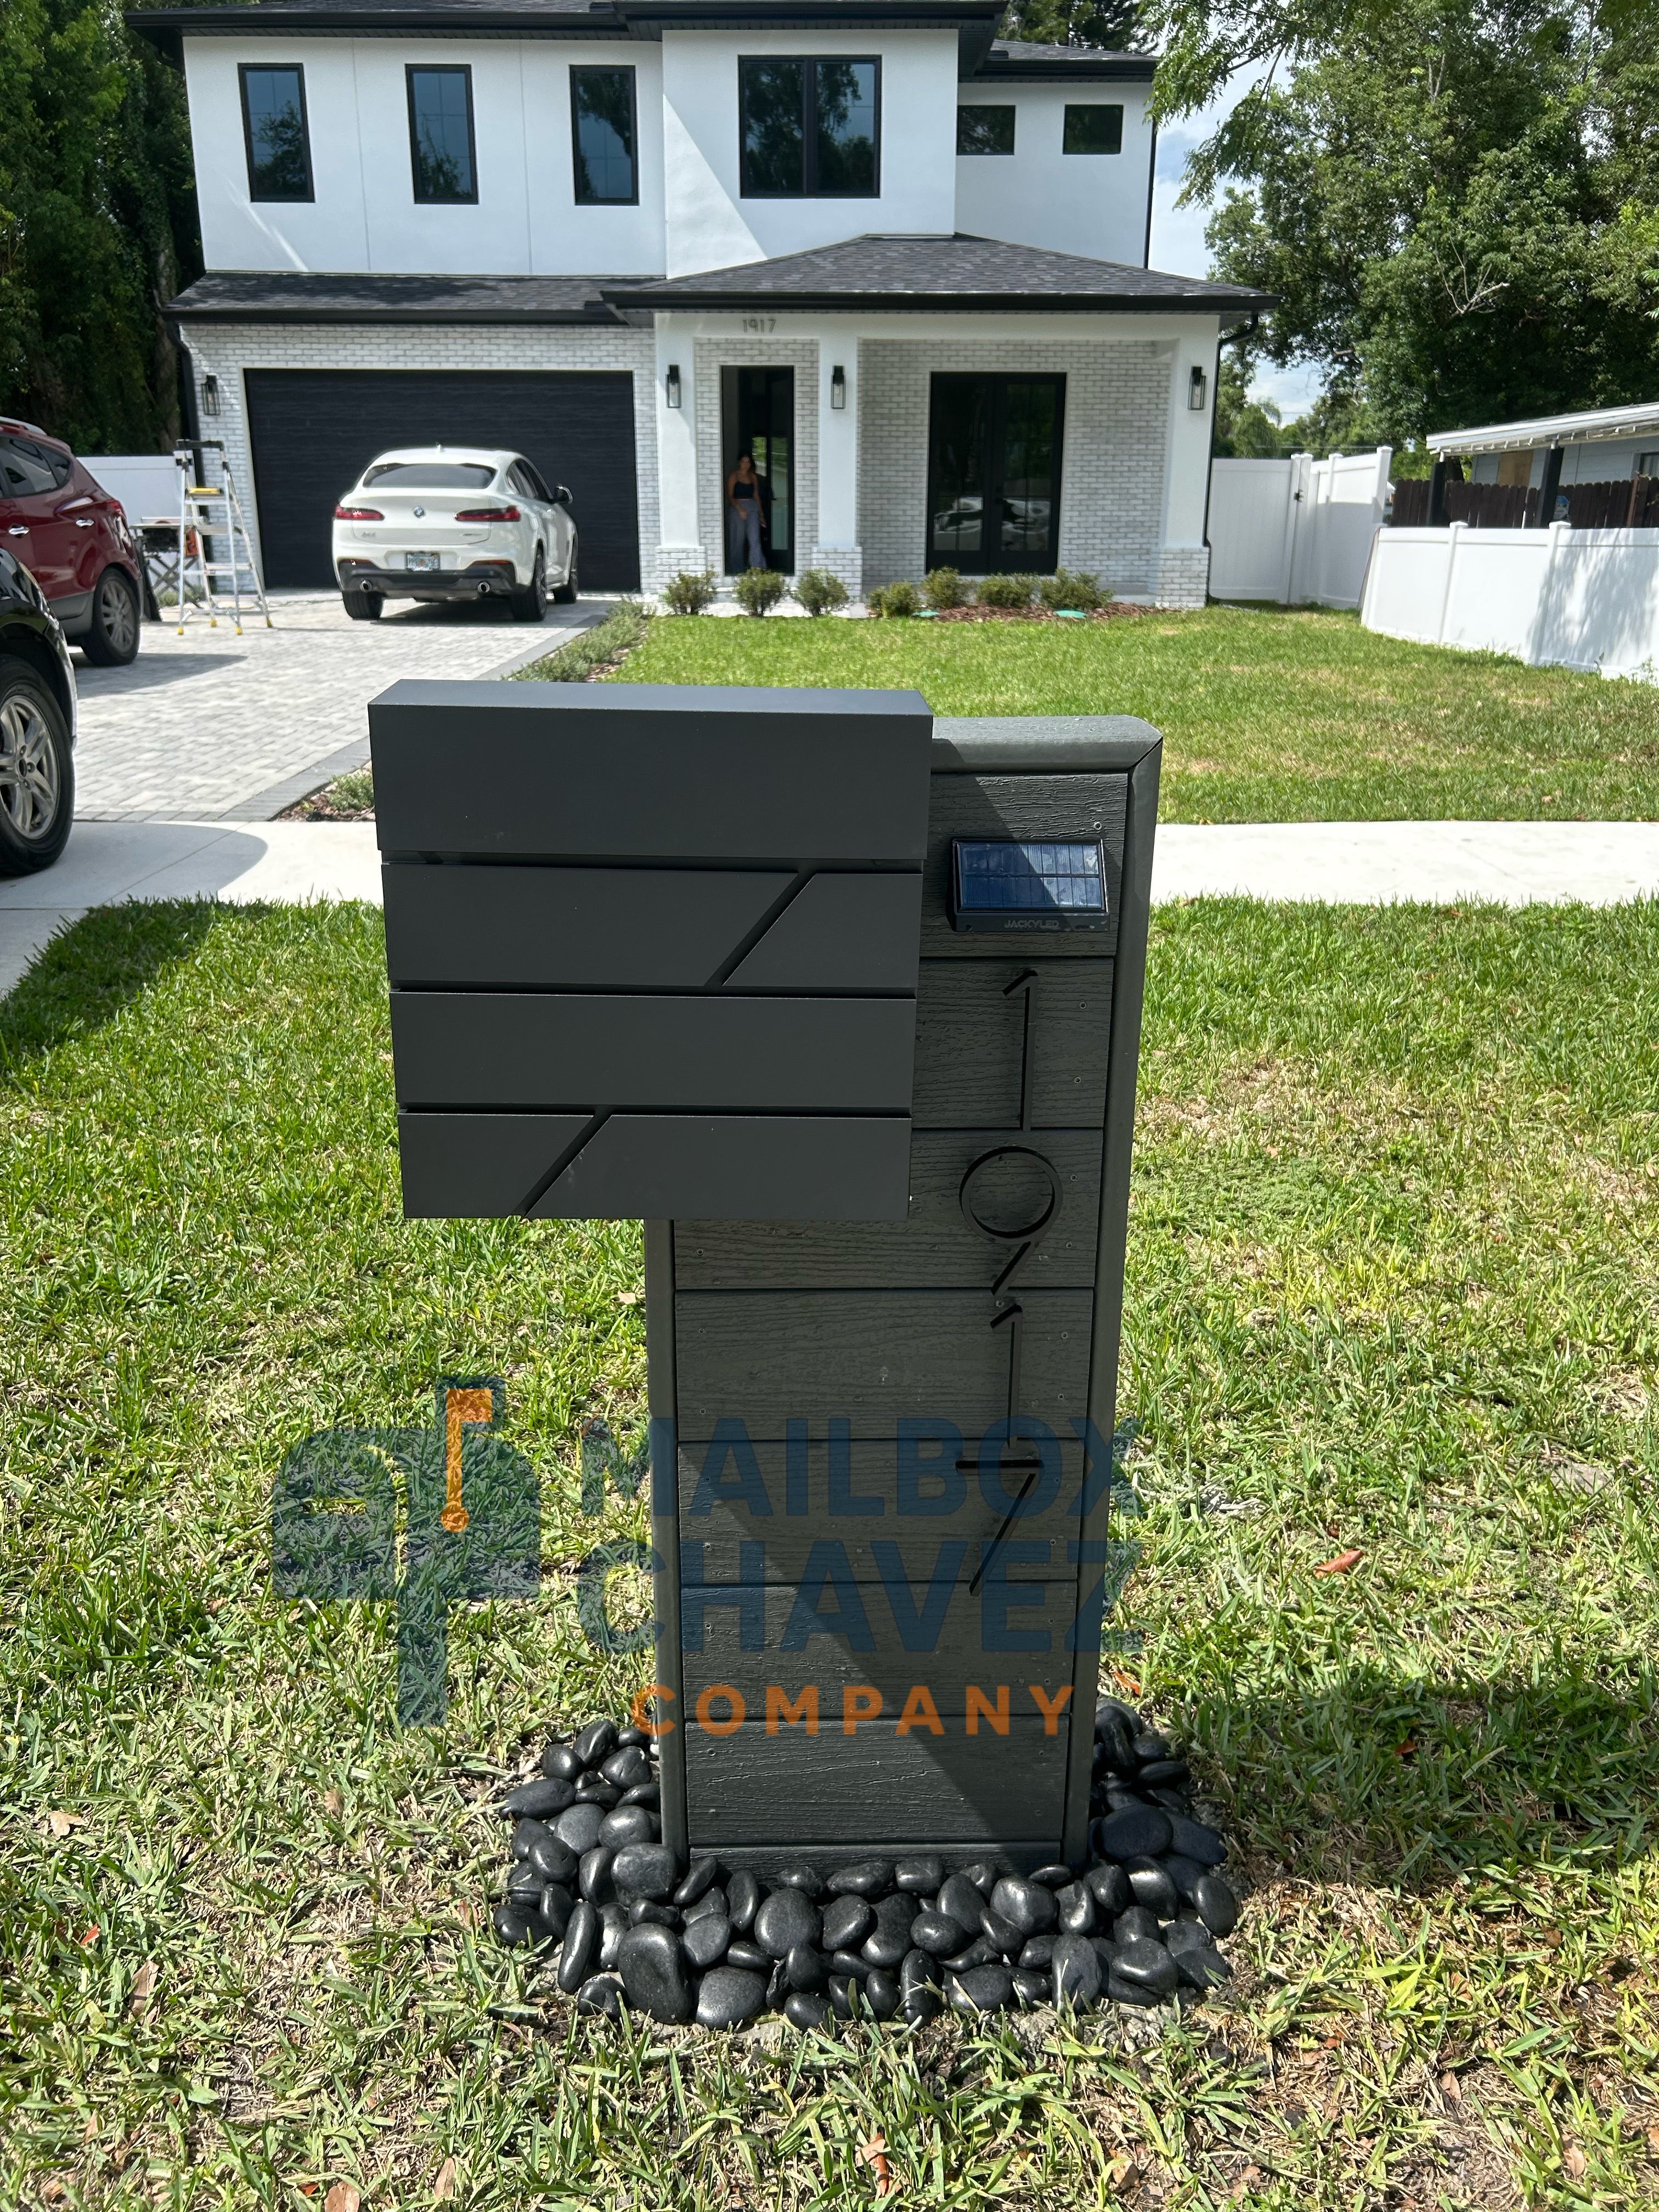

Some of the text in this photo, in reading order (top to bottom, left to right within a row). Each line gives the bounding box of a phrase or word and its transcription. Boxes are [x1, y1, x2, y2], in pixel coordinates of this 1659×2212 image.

[742, 319, 777, 333] 1917
[1004, 920, 1059, 928] JACKYLED
[955, 969, 1063, 1596] 1917
